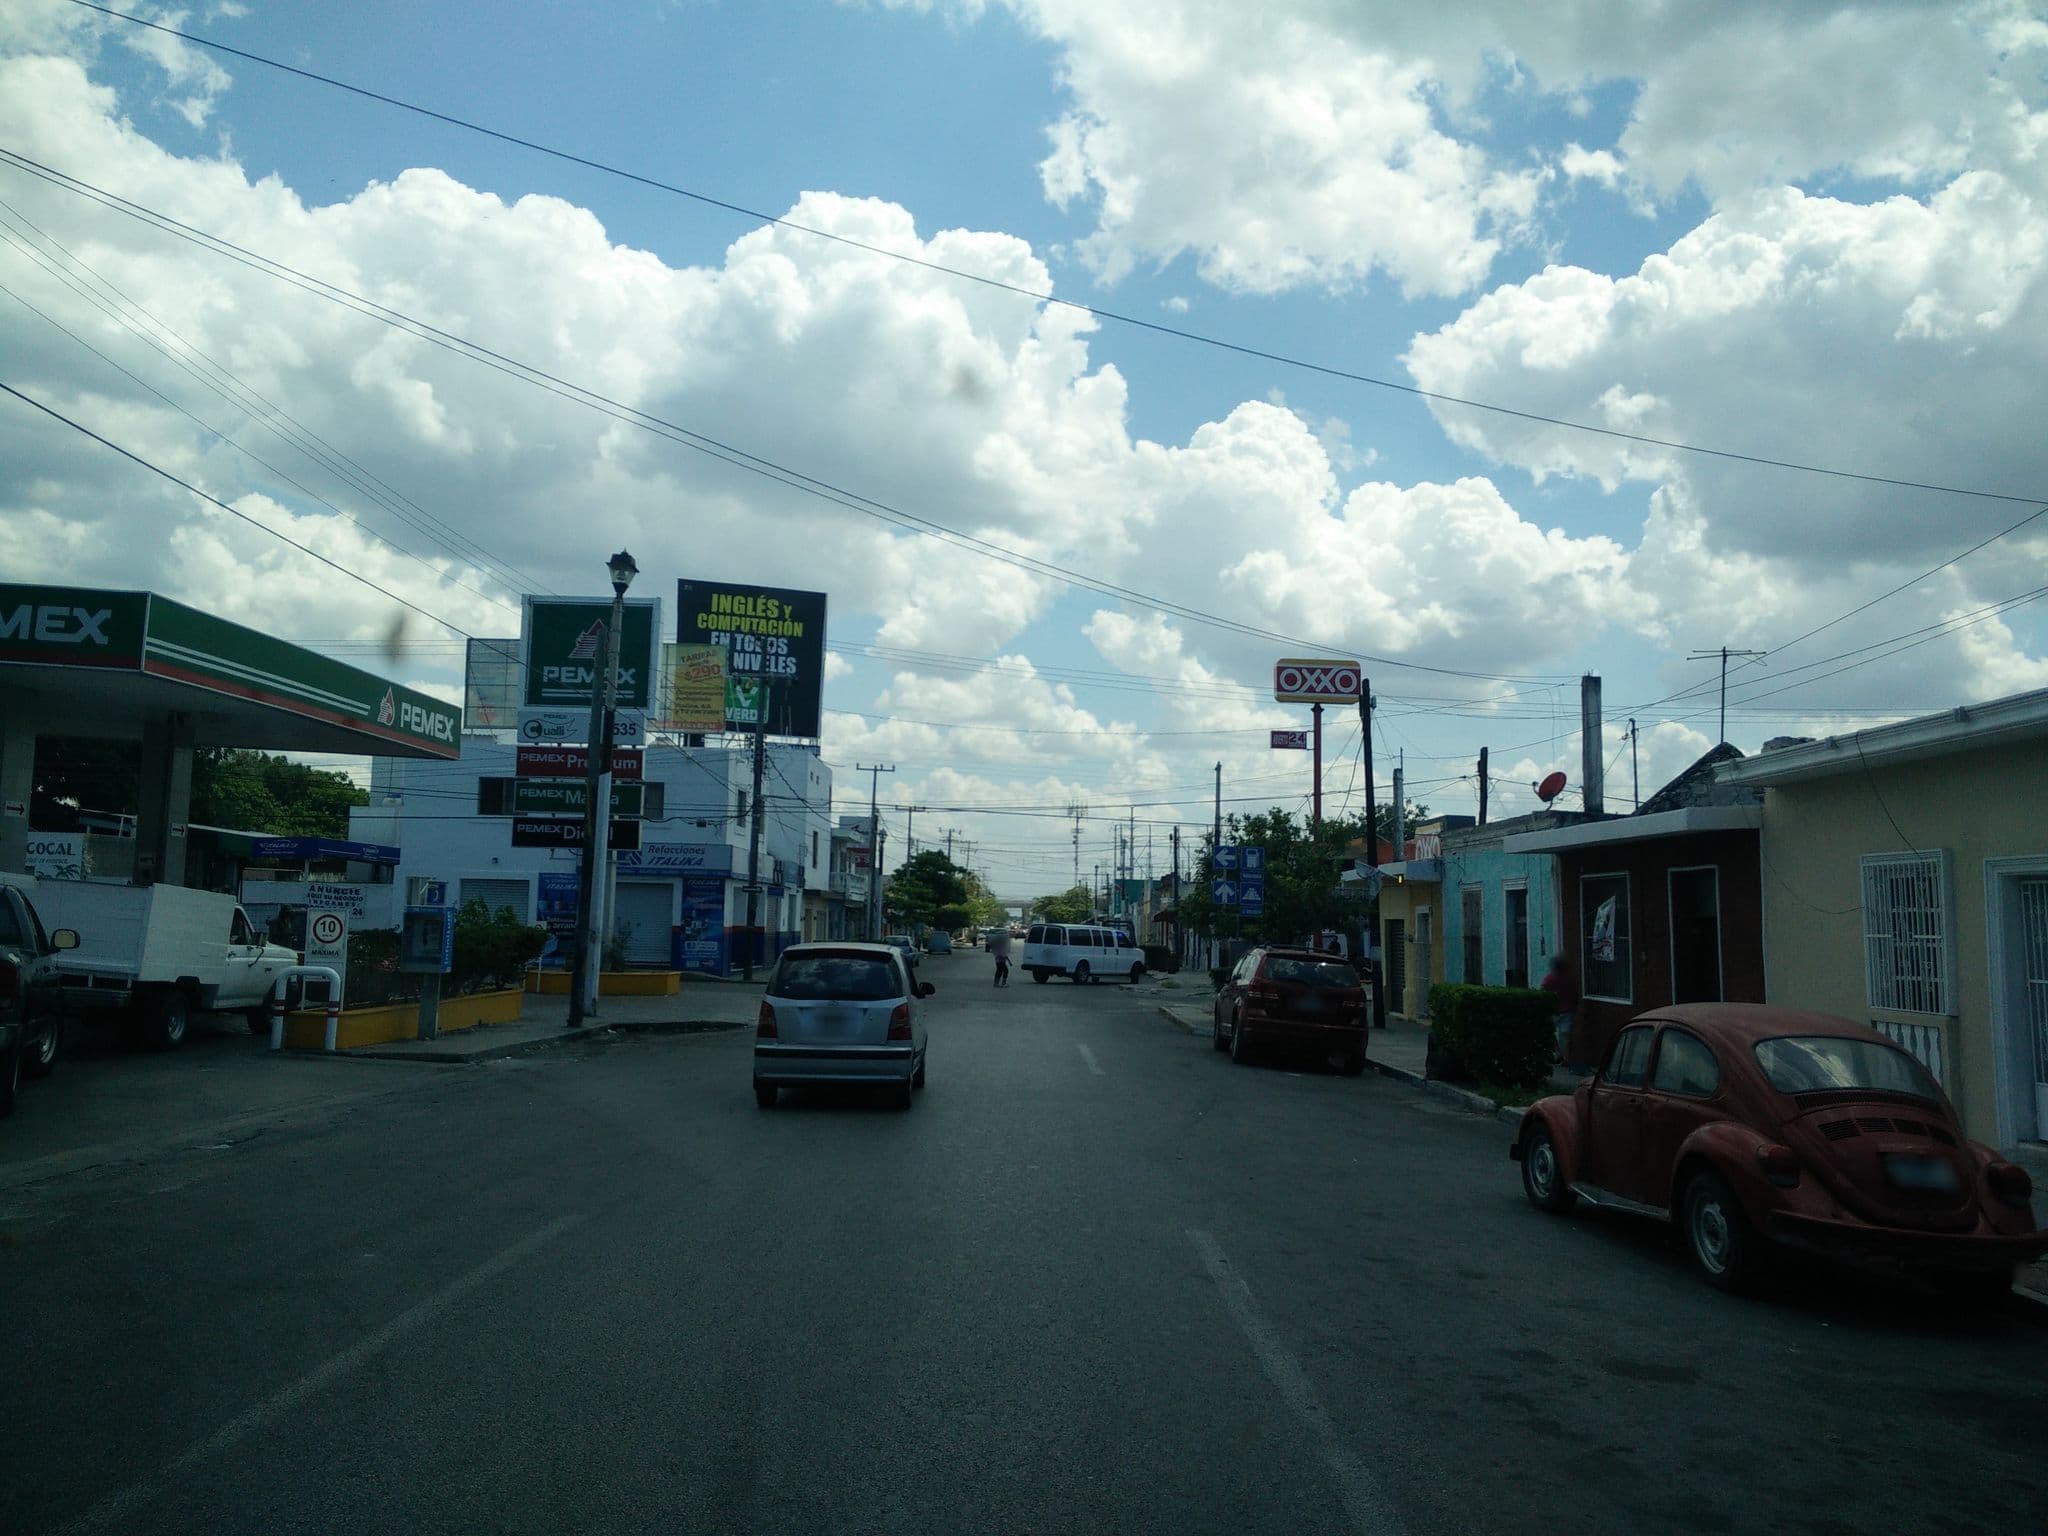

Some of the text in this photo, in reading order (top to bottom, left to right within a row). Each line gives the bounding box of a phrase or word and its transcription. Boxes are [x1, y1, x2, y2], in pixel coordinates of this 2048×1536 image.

[711, 593, 779, 618] INGLÉS
[697, 612, 804, 638] COMPUTACIÓN
[543, 665, 636, 685] PEMX
[1279, 667, 1358, 693] OXXO
[400, 702, 454, 742] PEMEX
[726, 707, 766, 721] VERD
[520, 752, 637, 769] PEMEX Prum
[519, 788, 620, 806] PEMEX Maa
[517, 824, 614, 840] PEMEX Dil
[648, 856, 704, 866] ITALIKA
[309, 885, 361, 895] ANUNCIE
[320, 920, 336, 933] 10
